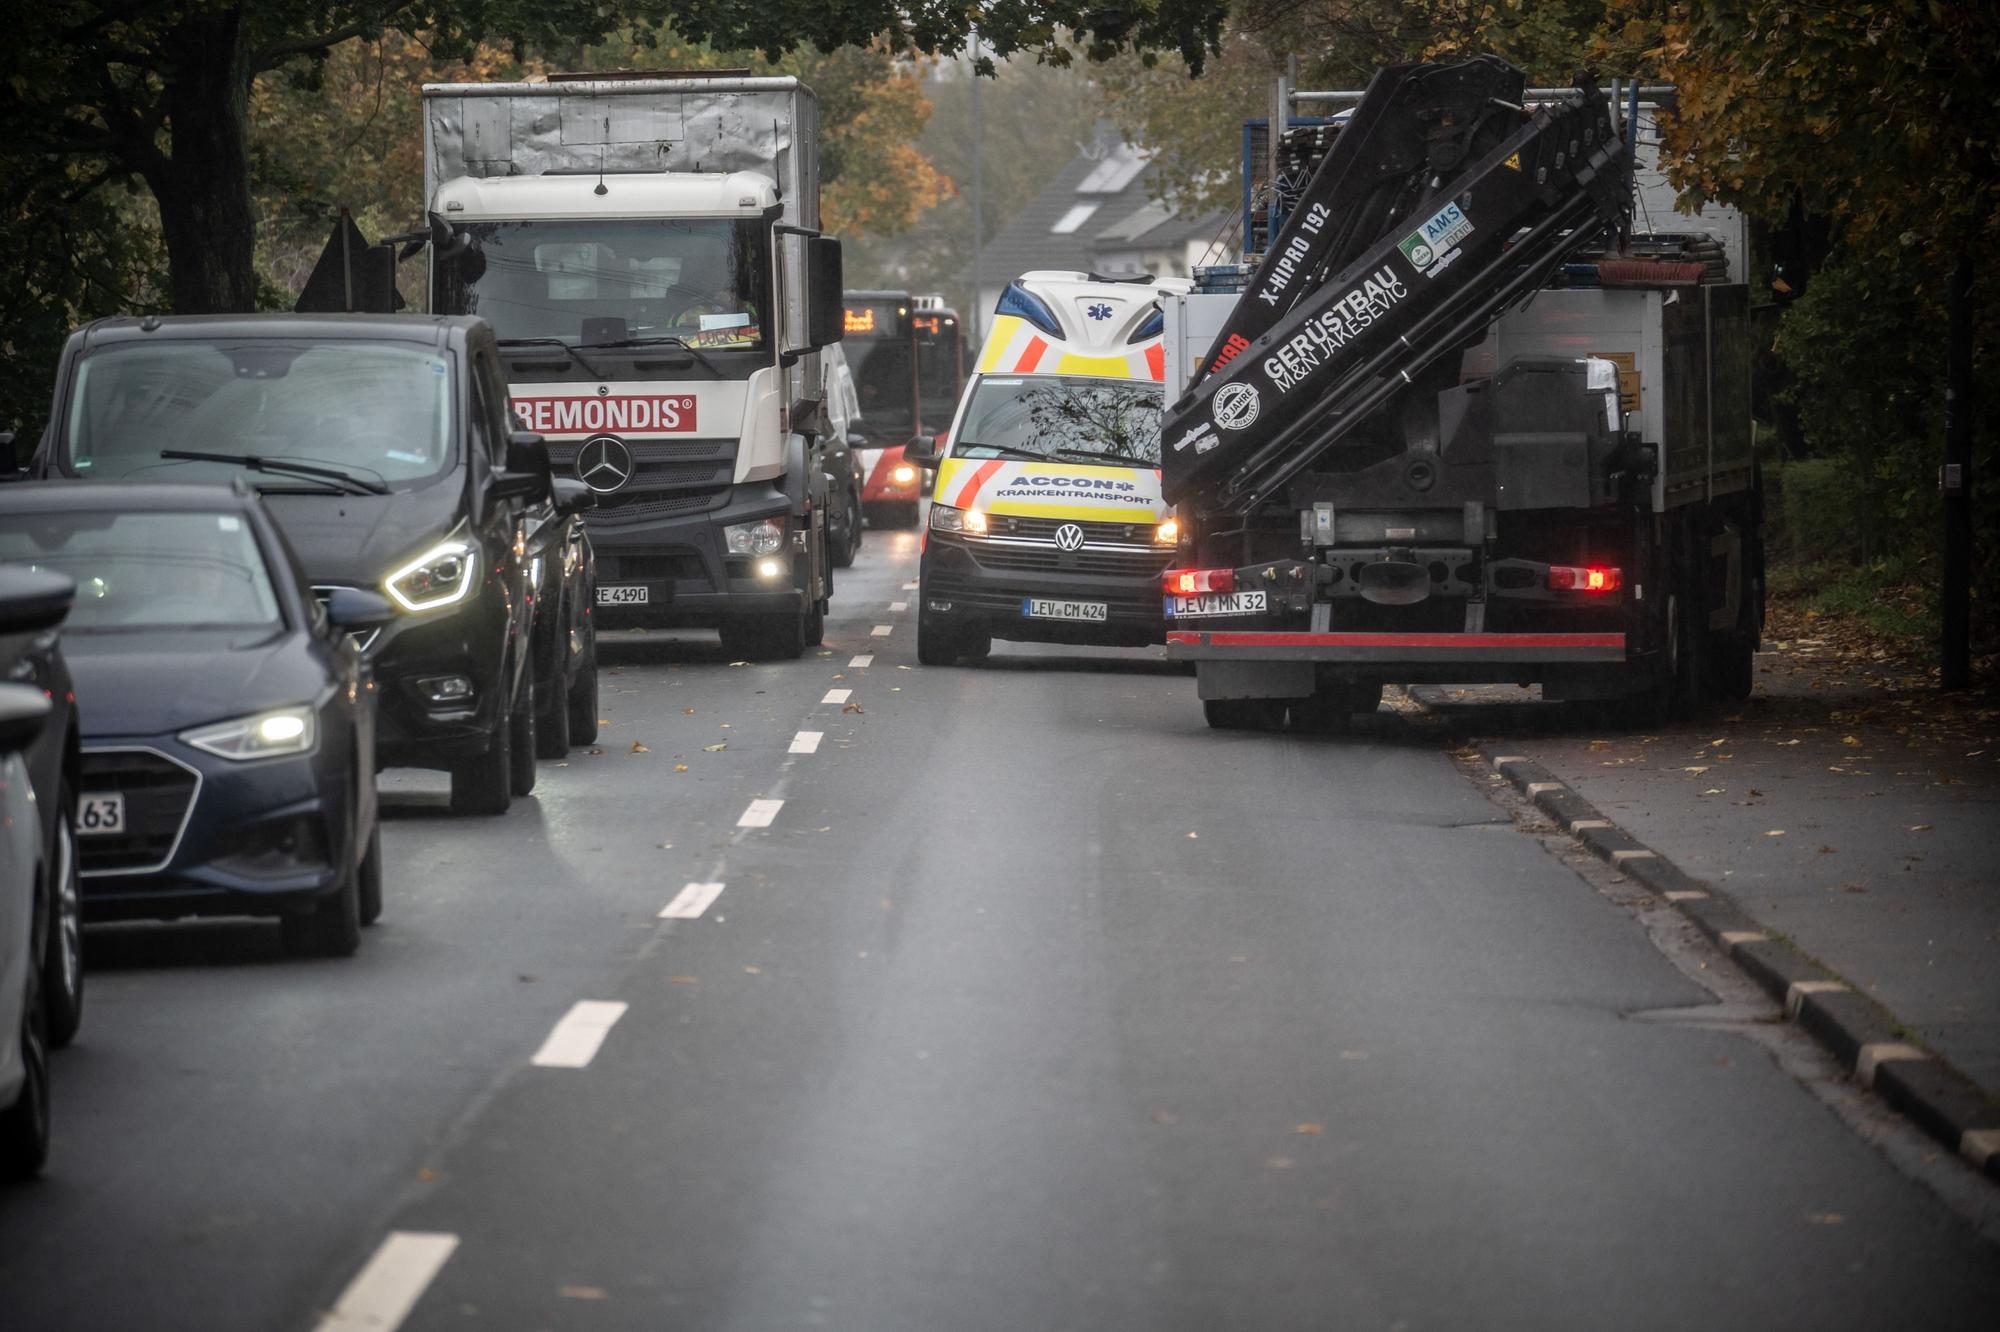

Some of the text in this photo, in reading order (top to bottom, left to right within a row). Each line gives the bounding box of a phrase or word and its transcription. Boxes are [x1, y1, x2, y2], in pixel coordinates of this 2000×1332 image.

[1427, 206, 1460, 238] AMS
[1445, 222, 1473, 248] BAU
[1259, 202, 1332, 307] X-HIPRO 192
[1264, 265, 1398, 379] GERÜSTBAU
[1274, 281, 1408, 394] M&N JAKESEVIC
[1220, 388, 1254, 425] 10 JAHRE
[1010, 476, 1114, 490] ACCON
[996, 489, 1153, 505] KRANKENTRANSPORT
[612, 588, 647, 602] 4190
[1174, 593, 1265, 614] LEV MN 32
[1031, 601, 1105, 619] LEV CM 424
[74, 800, 119, 829] 63
